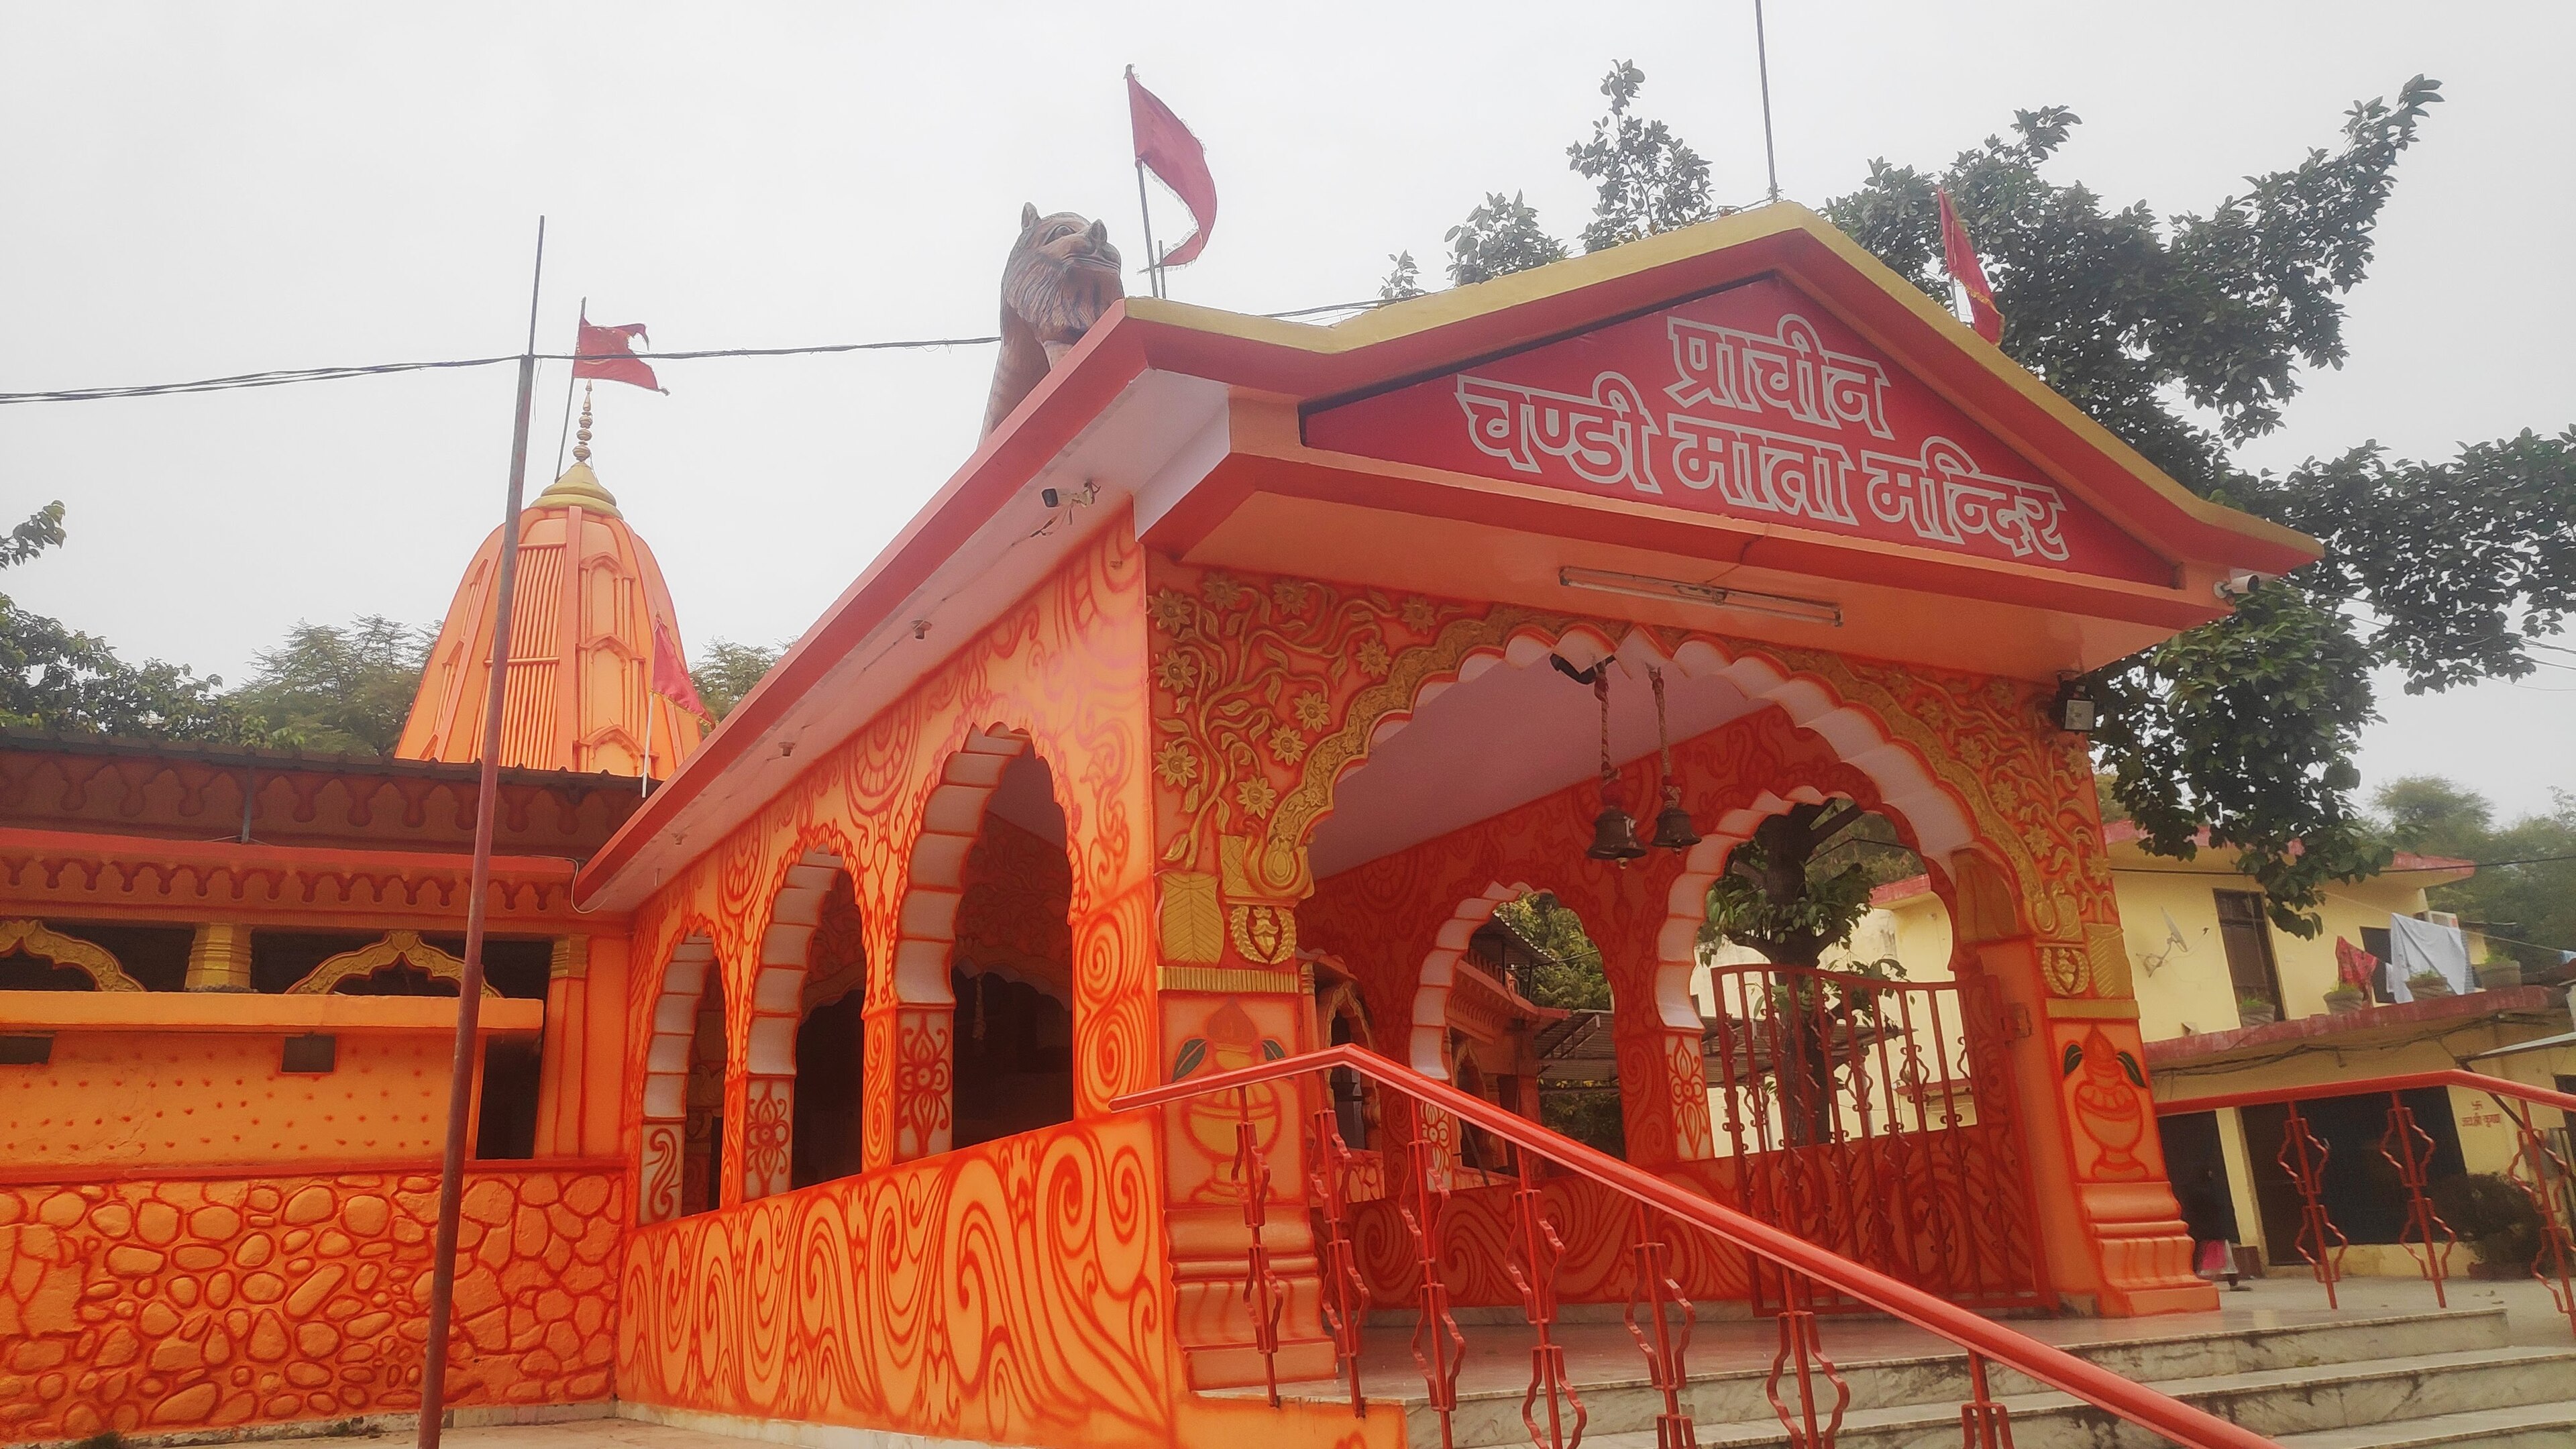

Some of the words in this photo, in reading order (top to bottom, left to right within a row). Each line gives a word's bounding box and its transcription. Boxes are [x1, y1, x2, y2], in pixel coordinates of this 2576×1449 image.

[1663, 314, 1895, 439] प्राचीन
[1455, 371, 1660, 494] चण्डी
[1668, 414, 1858, 525] माता
[1862, 436, 2069, 561] मन्दिर
